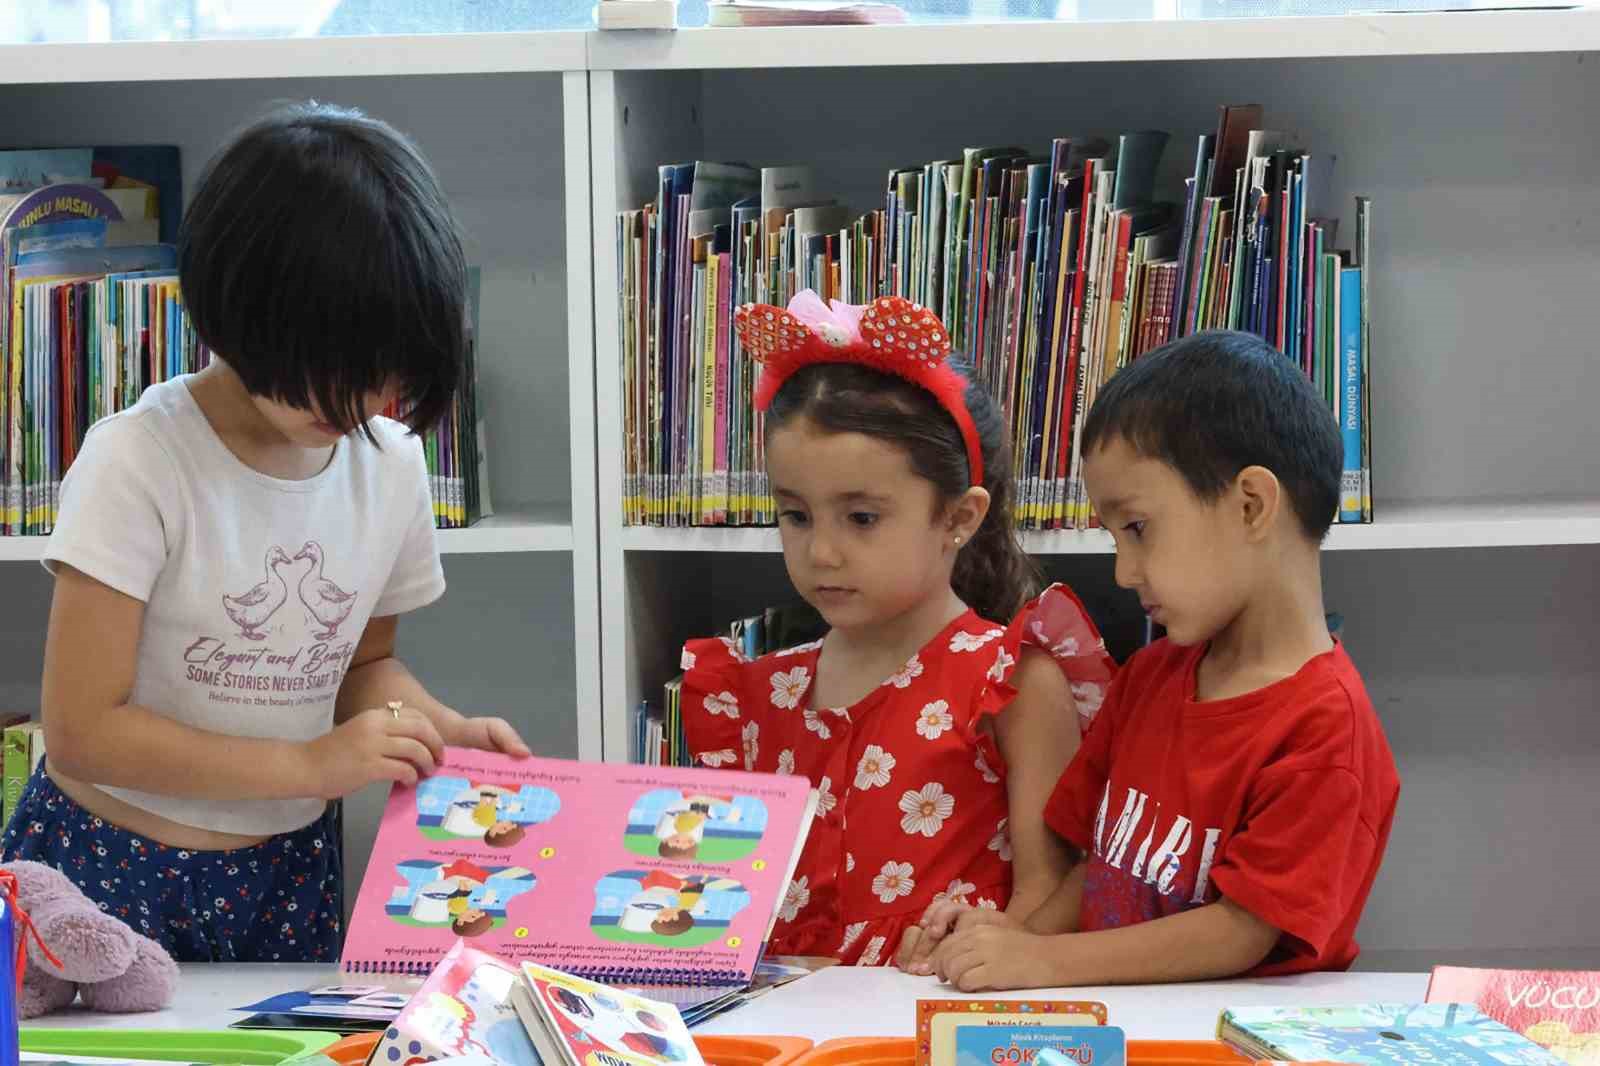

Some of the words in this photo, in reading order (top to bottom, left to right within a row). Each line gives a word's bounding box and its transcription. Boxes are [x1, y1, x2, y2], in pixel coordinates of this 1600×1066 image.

[1346, 350, 1358, 383] MASAL
[1346, 385, 1358, 430] DÜNYASI
[184, 636, 266, 672] Elegant
[266, 647, 303, 672] and
[186, 664, 222, 687] SOME
[223, 669, 270, 691] STORIES
[272, 675, 304, 691] NEVER
